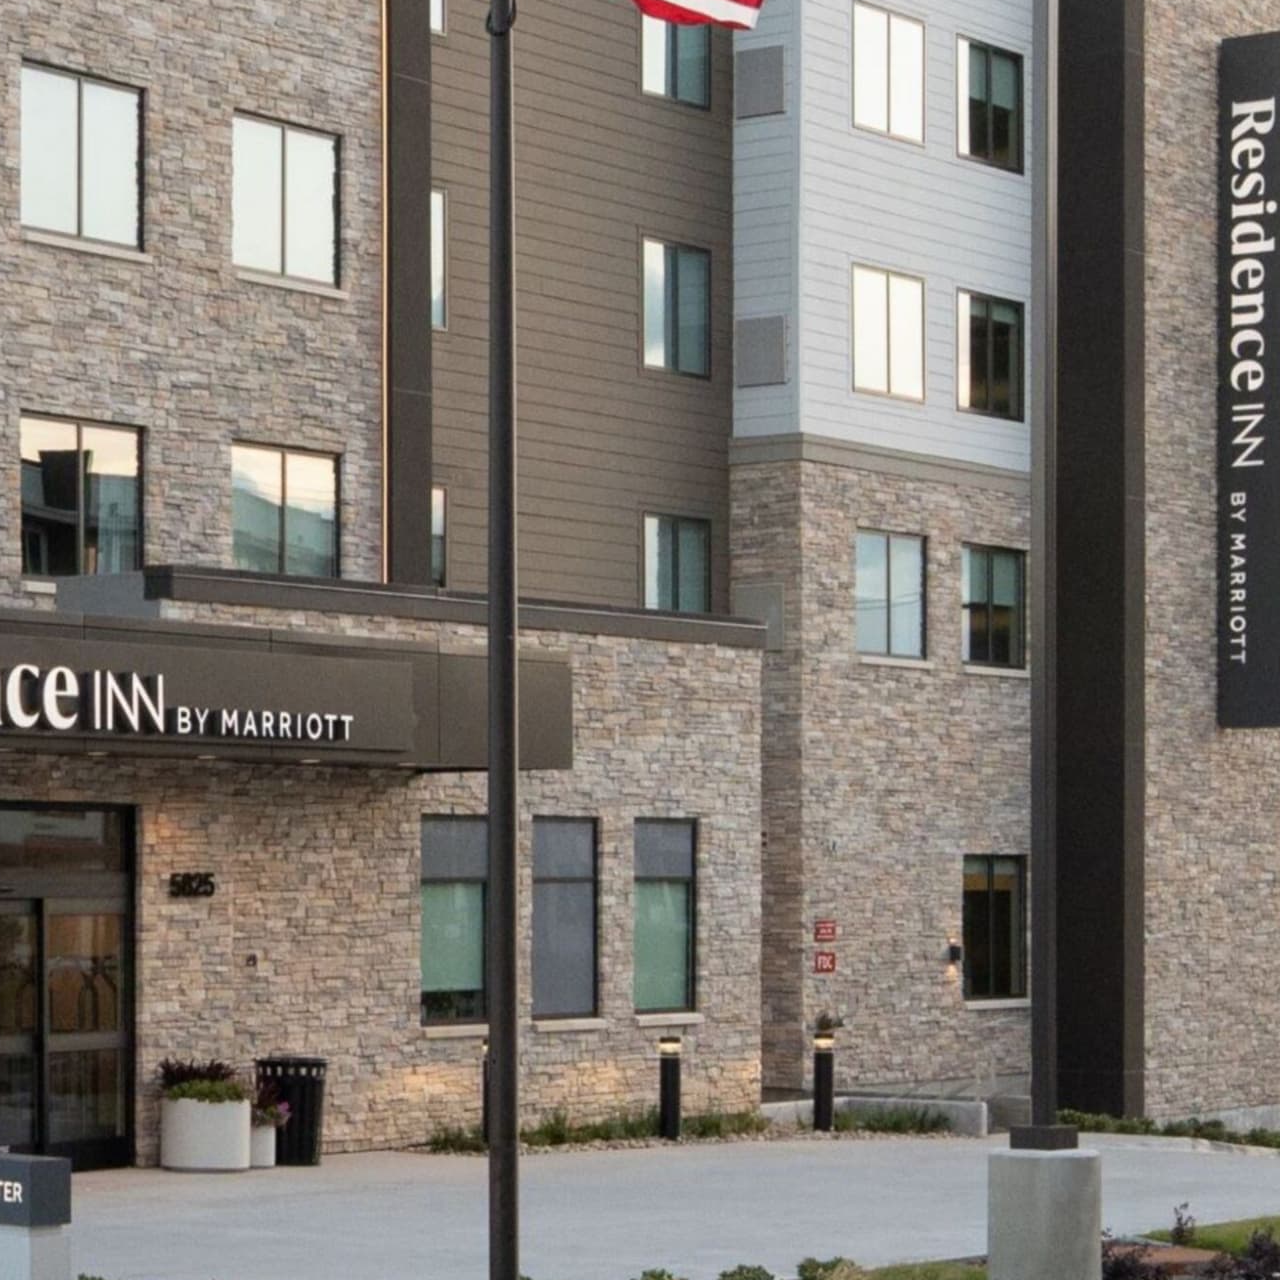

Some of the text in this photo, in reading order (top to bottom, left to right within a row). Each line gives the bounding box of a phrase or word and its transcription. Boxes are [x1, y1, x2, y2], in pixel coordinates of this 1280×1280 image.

[1229, 96, 1278, 664] Residence INN BY MARRIOTT
[93, 669, 165, 734] INN
[176, 706, 210, 735] BY
[220, 708, 354, 742] MARRIOTT
[168, 871, 215, 897] 5825
